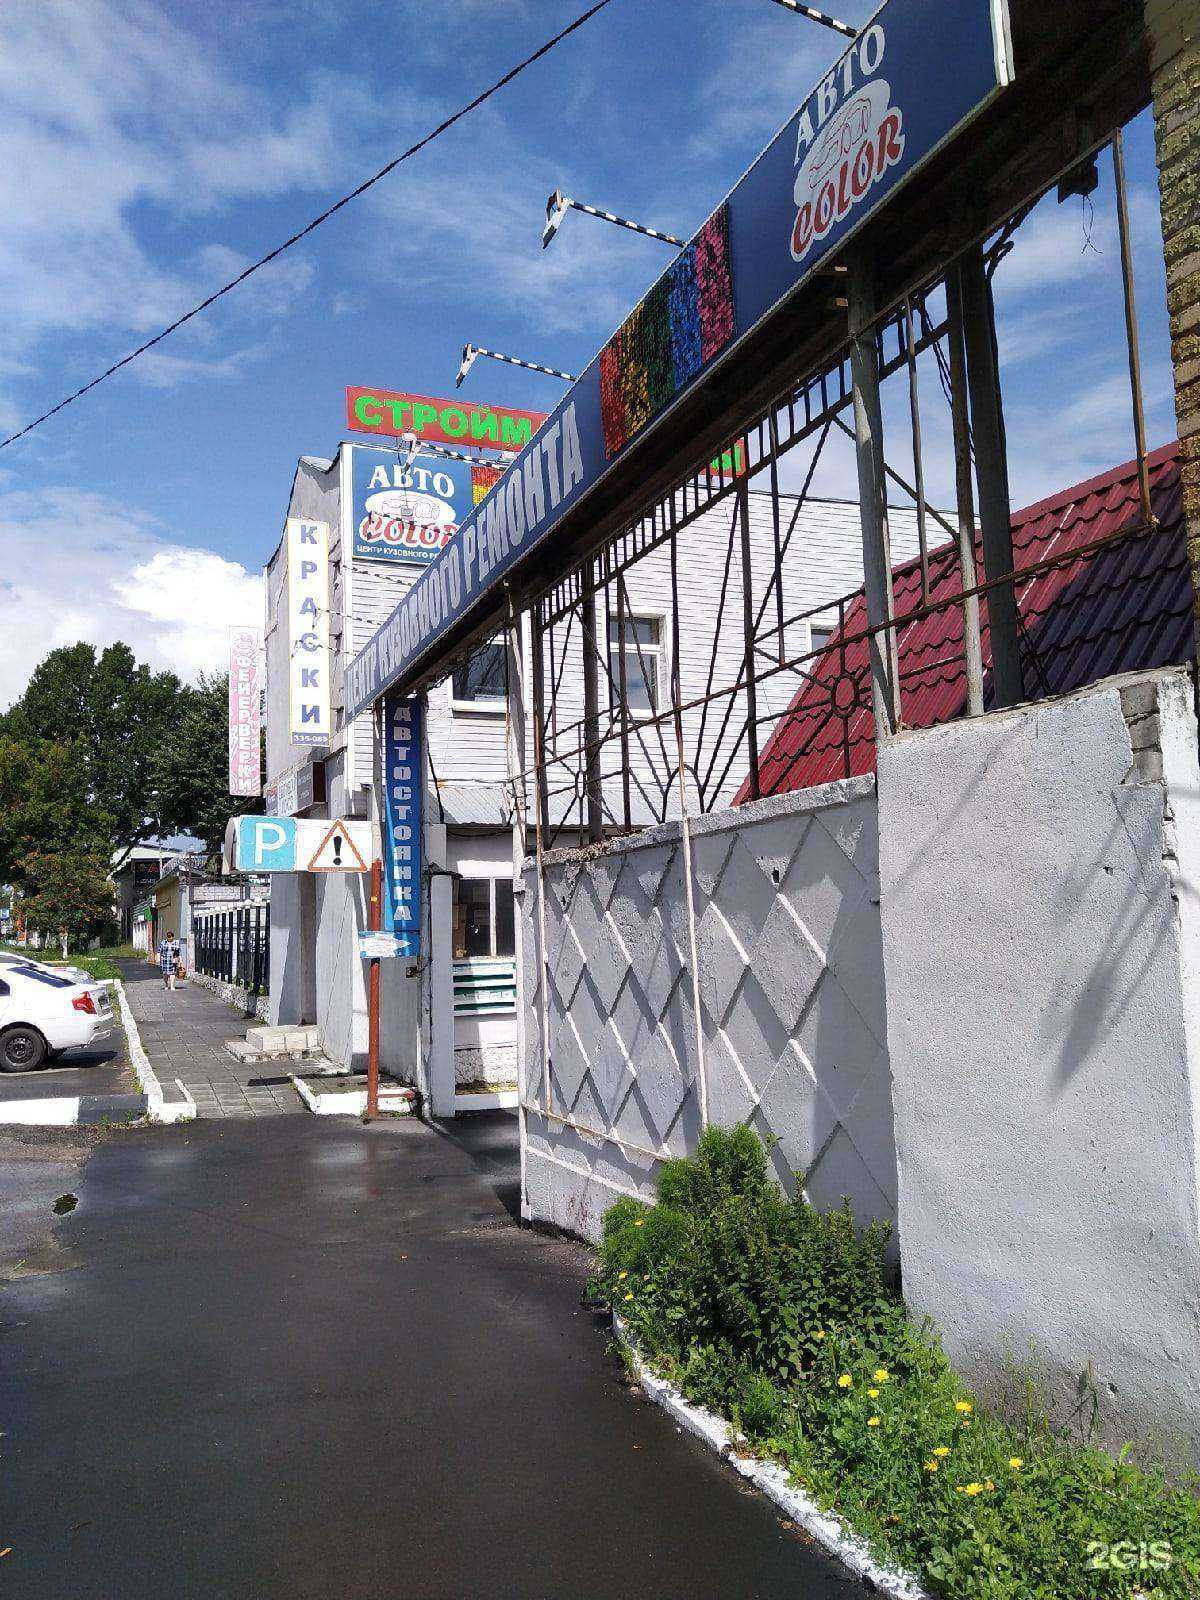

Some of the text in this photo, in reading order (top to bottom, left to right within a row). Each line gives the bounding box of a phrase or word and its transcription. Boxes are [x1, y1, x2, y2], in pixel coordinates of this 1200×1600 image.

[793, 24, 886, 167] АВТО
[792, 111, 904, 257] COLOR
[356, 544, 382, 553] ЦЕНТР
[383, 548, 429, 559] КУЗОВНОГО
[367, 464, 455, 498] АВТО
[378, 543, 461, 682] КУЗОВНОГО
[463, 401, 584, 594] РЕМОНТА
[299, 524, 321, 724] КРАСКИ
[254, 821, 286, 865] P
[393, 706, 412, 921] АВТОСТОЯНКА
